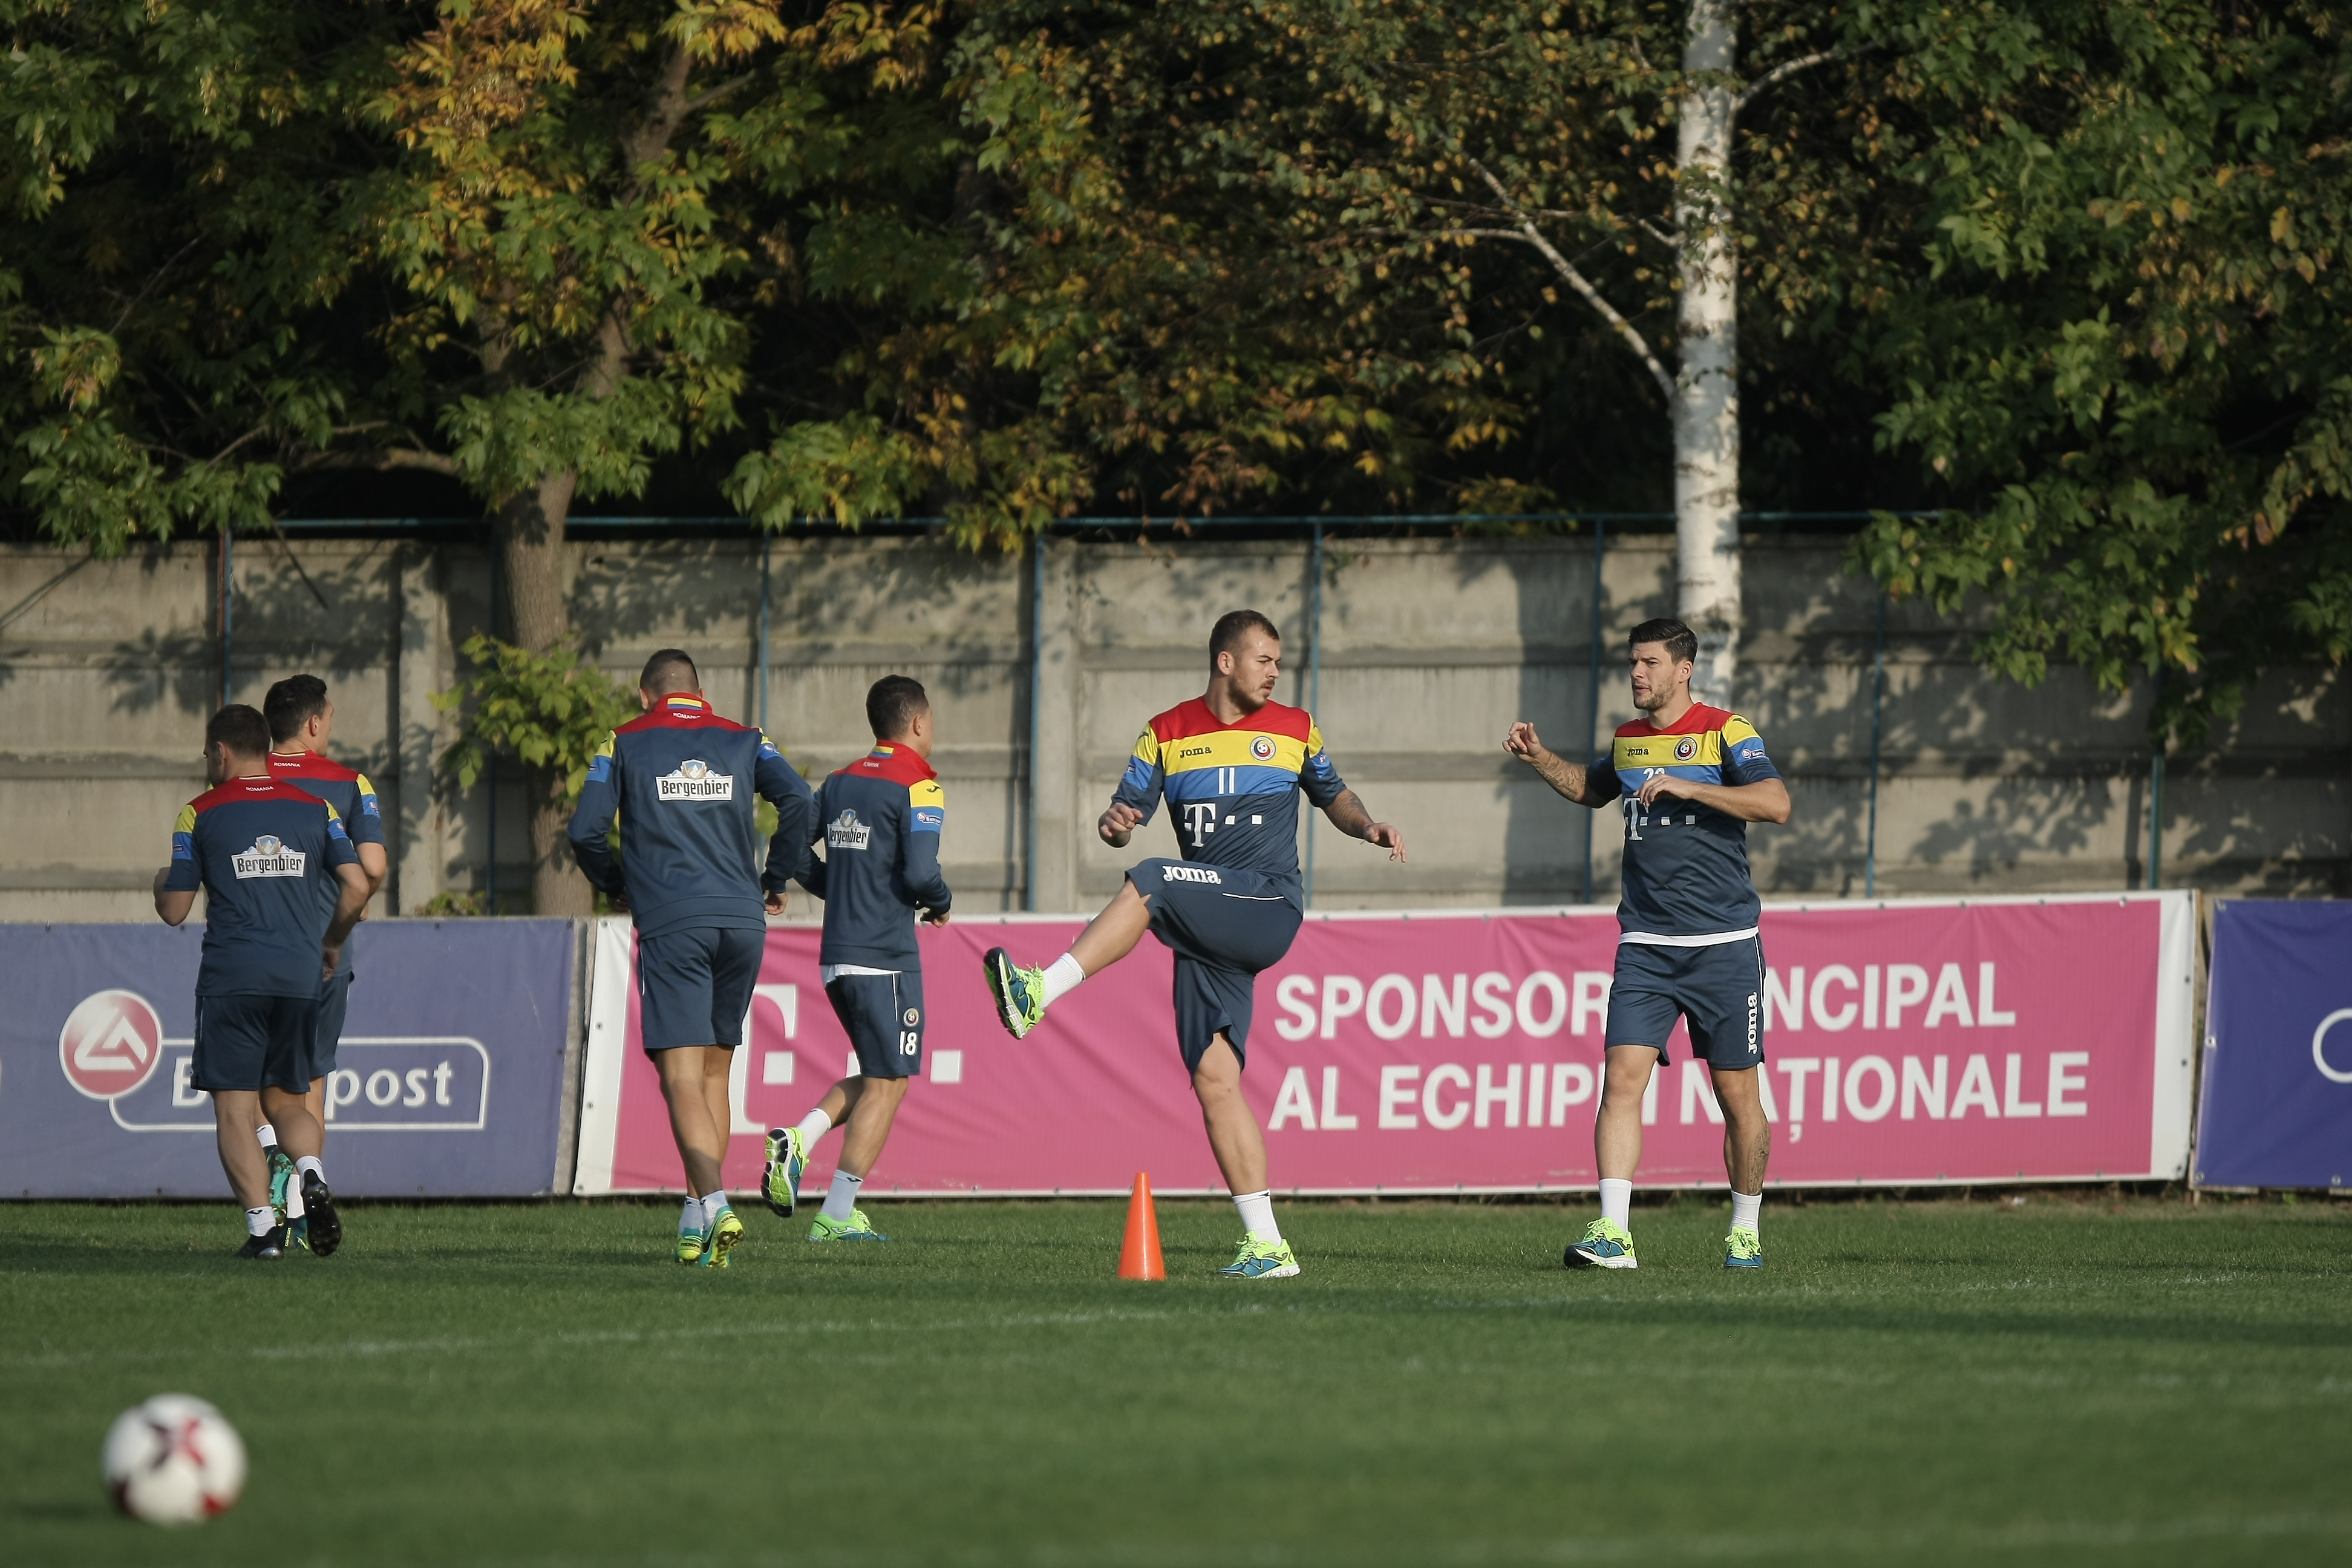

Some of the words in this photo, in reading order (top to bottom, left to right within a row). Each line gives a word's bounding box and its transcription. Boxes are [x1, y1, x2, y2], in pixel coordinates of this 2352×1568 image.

[661, 779, 730, 797] Bergenbier
[237, 855, 302, 874] Bergenbier
[1274, 970, 1614, 1041] SPONSOR
[1684, 961, 2016, 1034] NCIPAL
[900, 1031, 917, 1055] 18
[172, 1056, 452, 1120] Bpost
[1267, 1065, 1359, 1131] AL
[1378, 1062, 1659, 1131] ECHIPI
